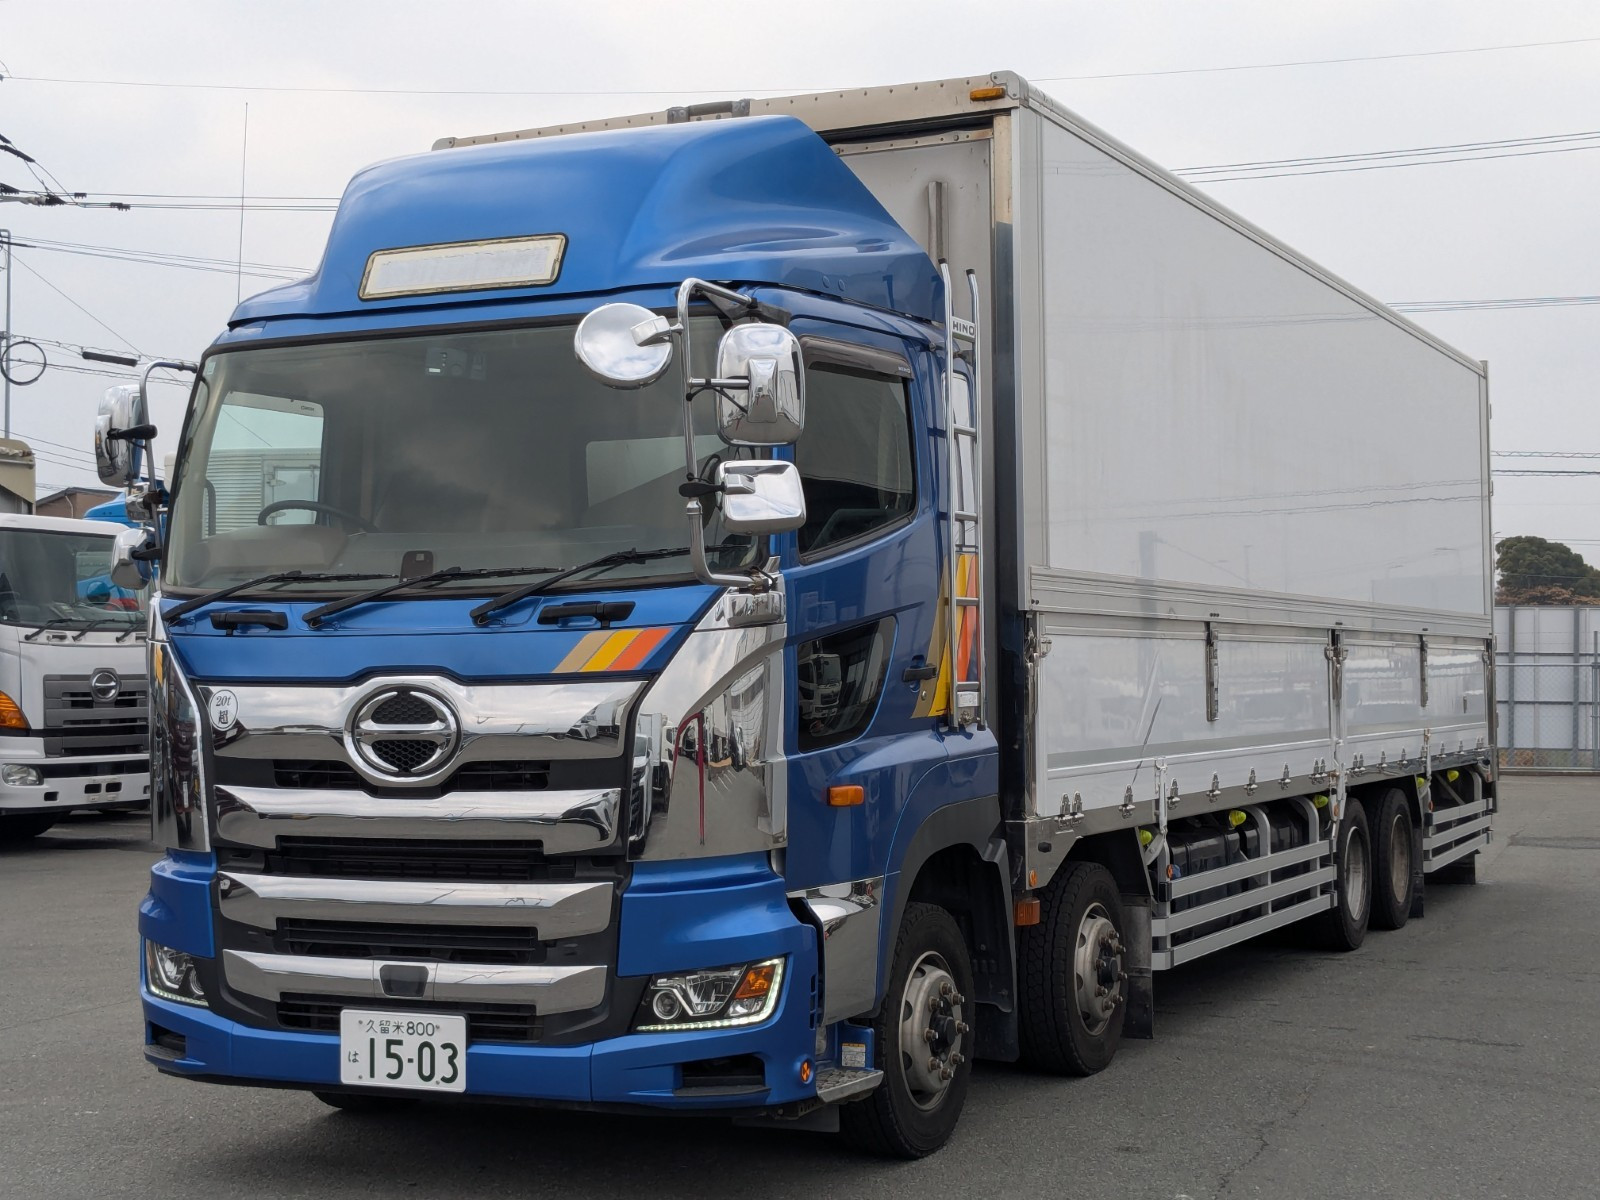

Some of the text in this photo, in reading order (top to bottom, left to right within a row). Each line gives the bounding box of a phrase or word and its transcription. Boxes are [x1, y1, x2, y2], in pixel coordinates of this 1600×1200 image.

[952, 320, 975, 335] HINO
[216, 695, 231, 706] 20t
[348, 1038, 458, 1083] は 15-03
